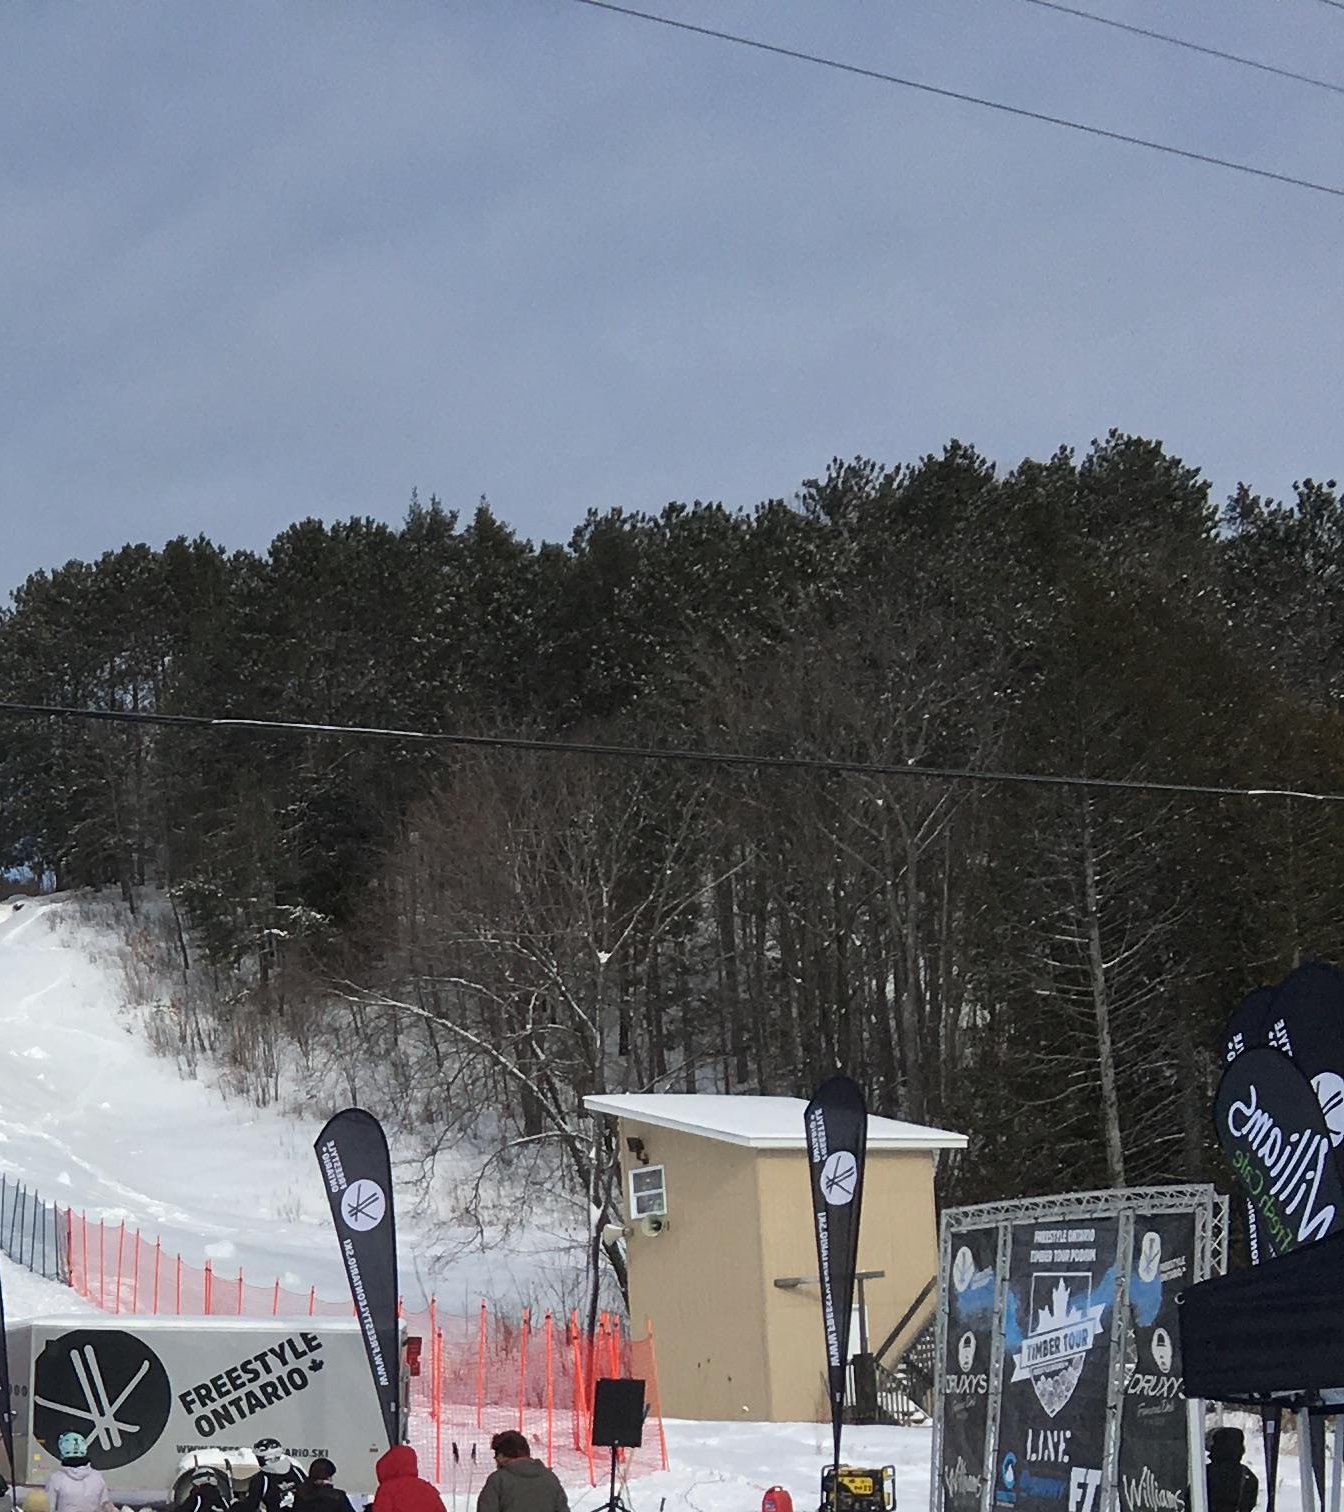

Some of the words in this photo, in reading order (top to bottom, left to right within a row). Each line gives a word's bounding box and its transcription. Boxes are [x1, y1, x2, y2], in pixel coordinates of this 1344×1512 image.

[1027, 1336, 1060, 1361] TIMBER
[1063, 1328, 1088, 1352] TOUR
[178, 1332, 323, 1415] FREESTYLE
[194, 1367, 309, 1438] ONTARIO
[1026, 1428, 1072, 1463] LINE
